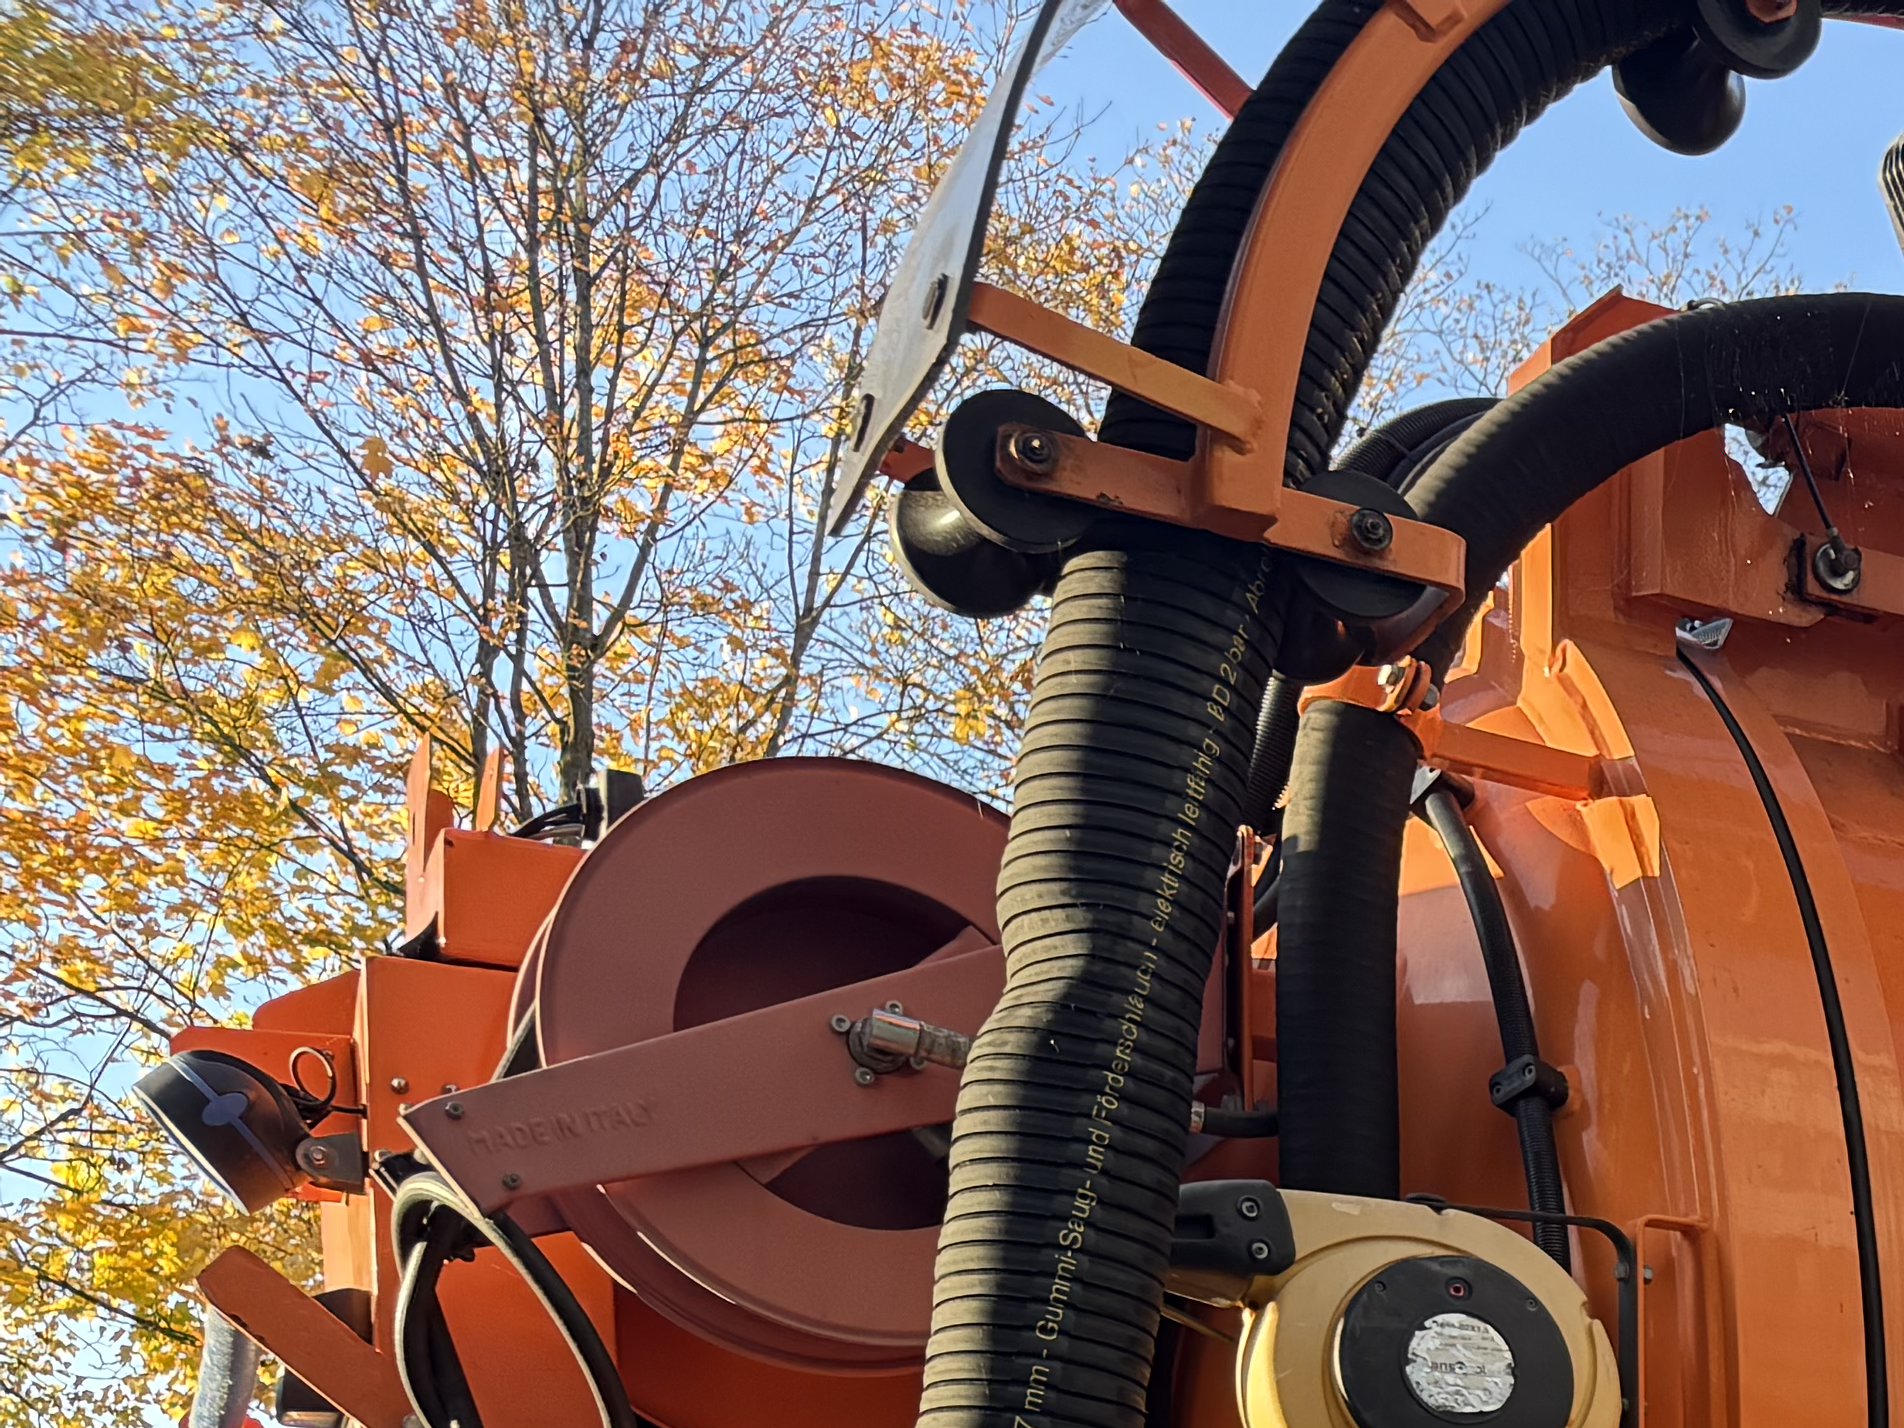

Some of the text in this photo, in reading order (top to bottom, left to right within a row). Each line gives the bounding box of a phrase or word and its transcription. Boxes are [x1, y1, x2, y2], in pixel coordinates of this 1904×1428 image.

[467, 1100, 655, 1155] MADE IN ITALY
[1025, 1366, 1049, 1412] mm
[1079, 1129, 1111, 1174] und
[1151, 828, 1194, 932] elektrisch
[1220, 663, 1237, 686] 2
